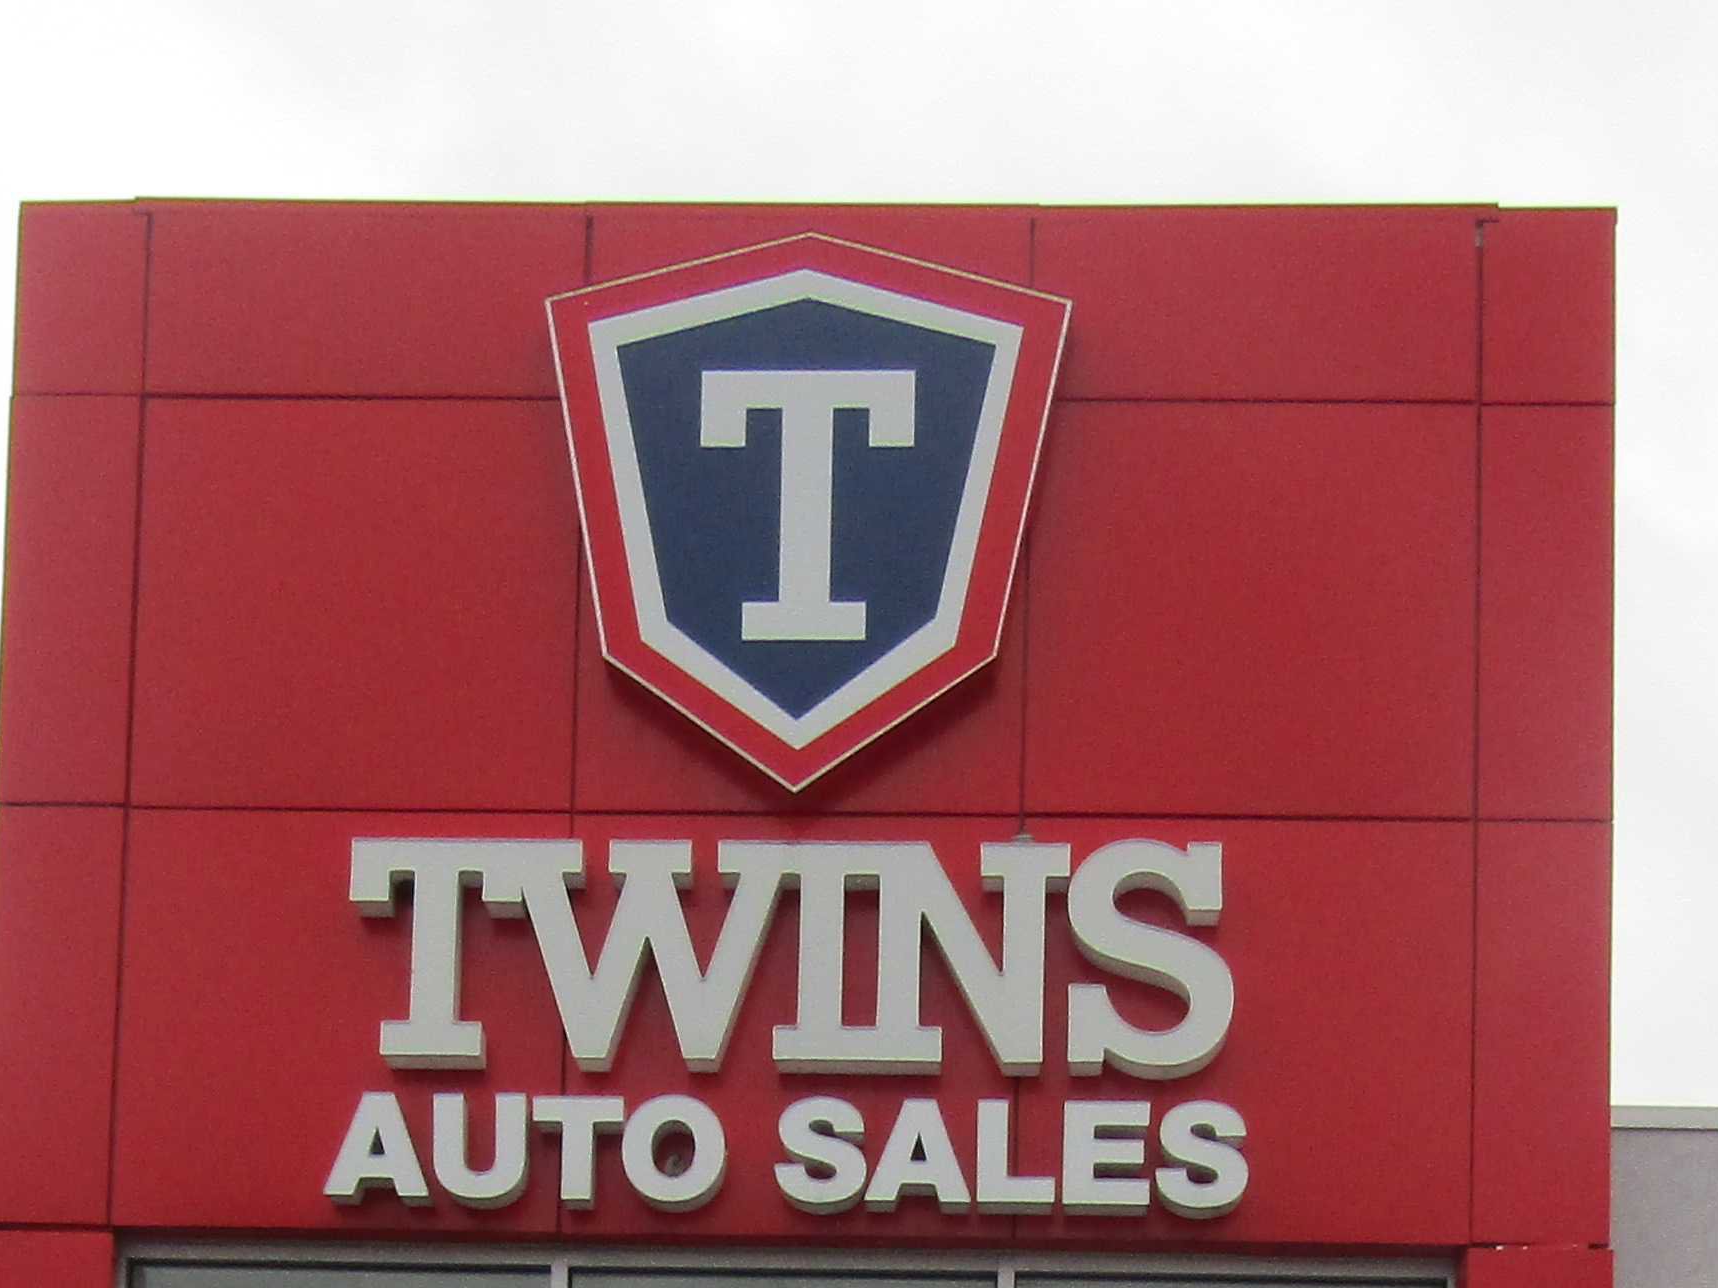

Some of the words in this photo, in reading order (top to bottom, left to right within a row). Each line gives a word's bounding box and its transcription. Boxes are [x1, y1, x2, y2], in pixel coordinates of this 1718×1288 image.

[700, 369, 916, 641] T
[349, 836, 1235, 1081] TWINS
[323, 1090, 729, 1213] AUTO
[773, 1095, 1250, 1220] SALES
